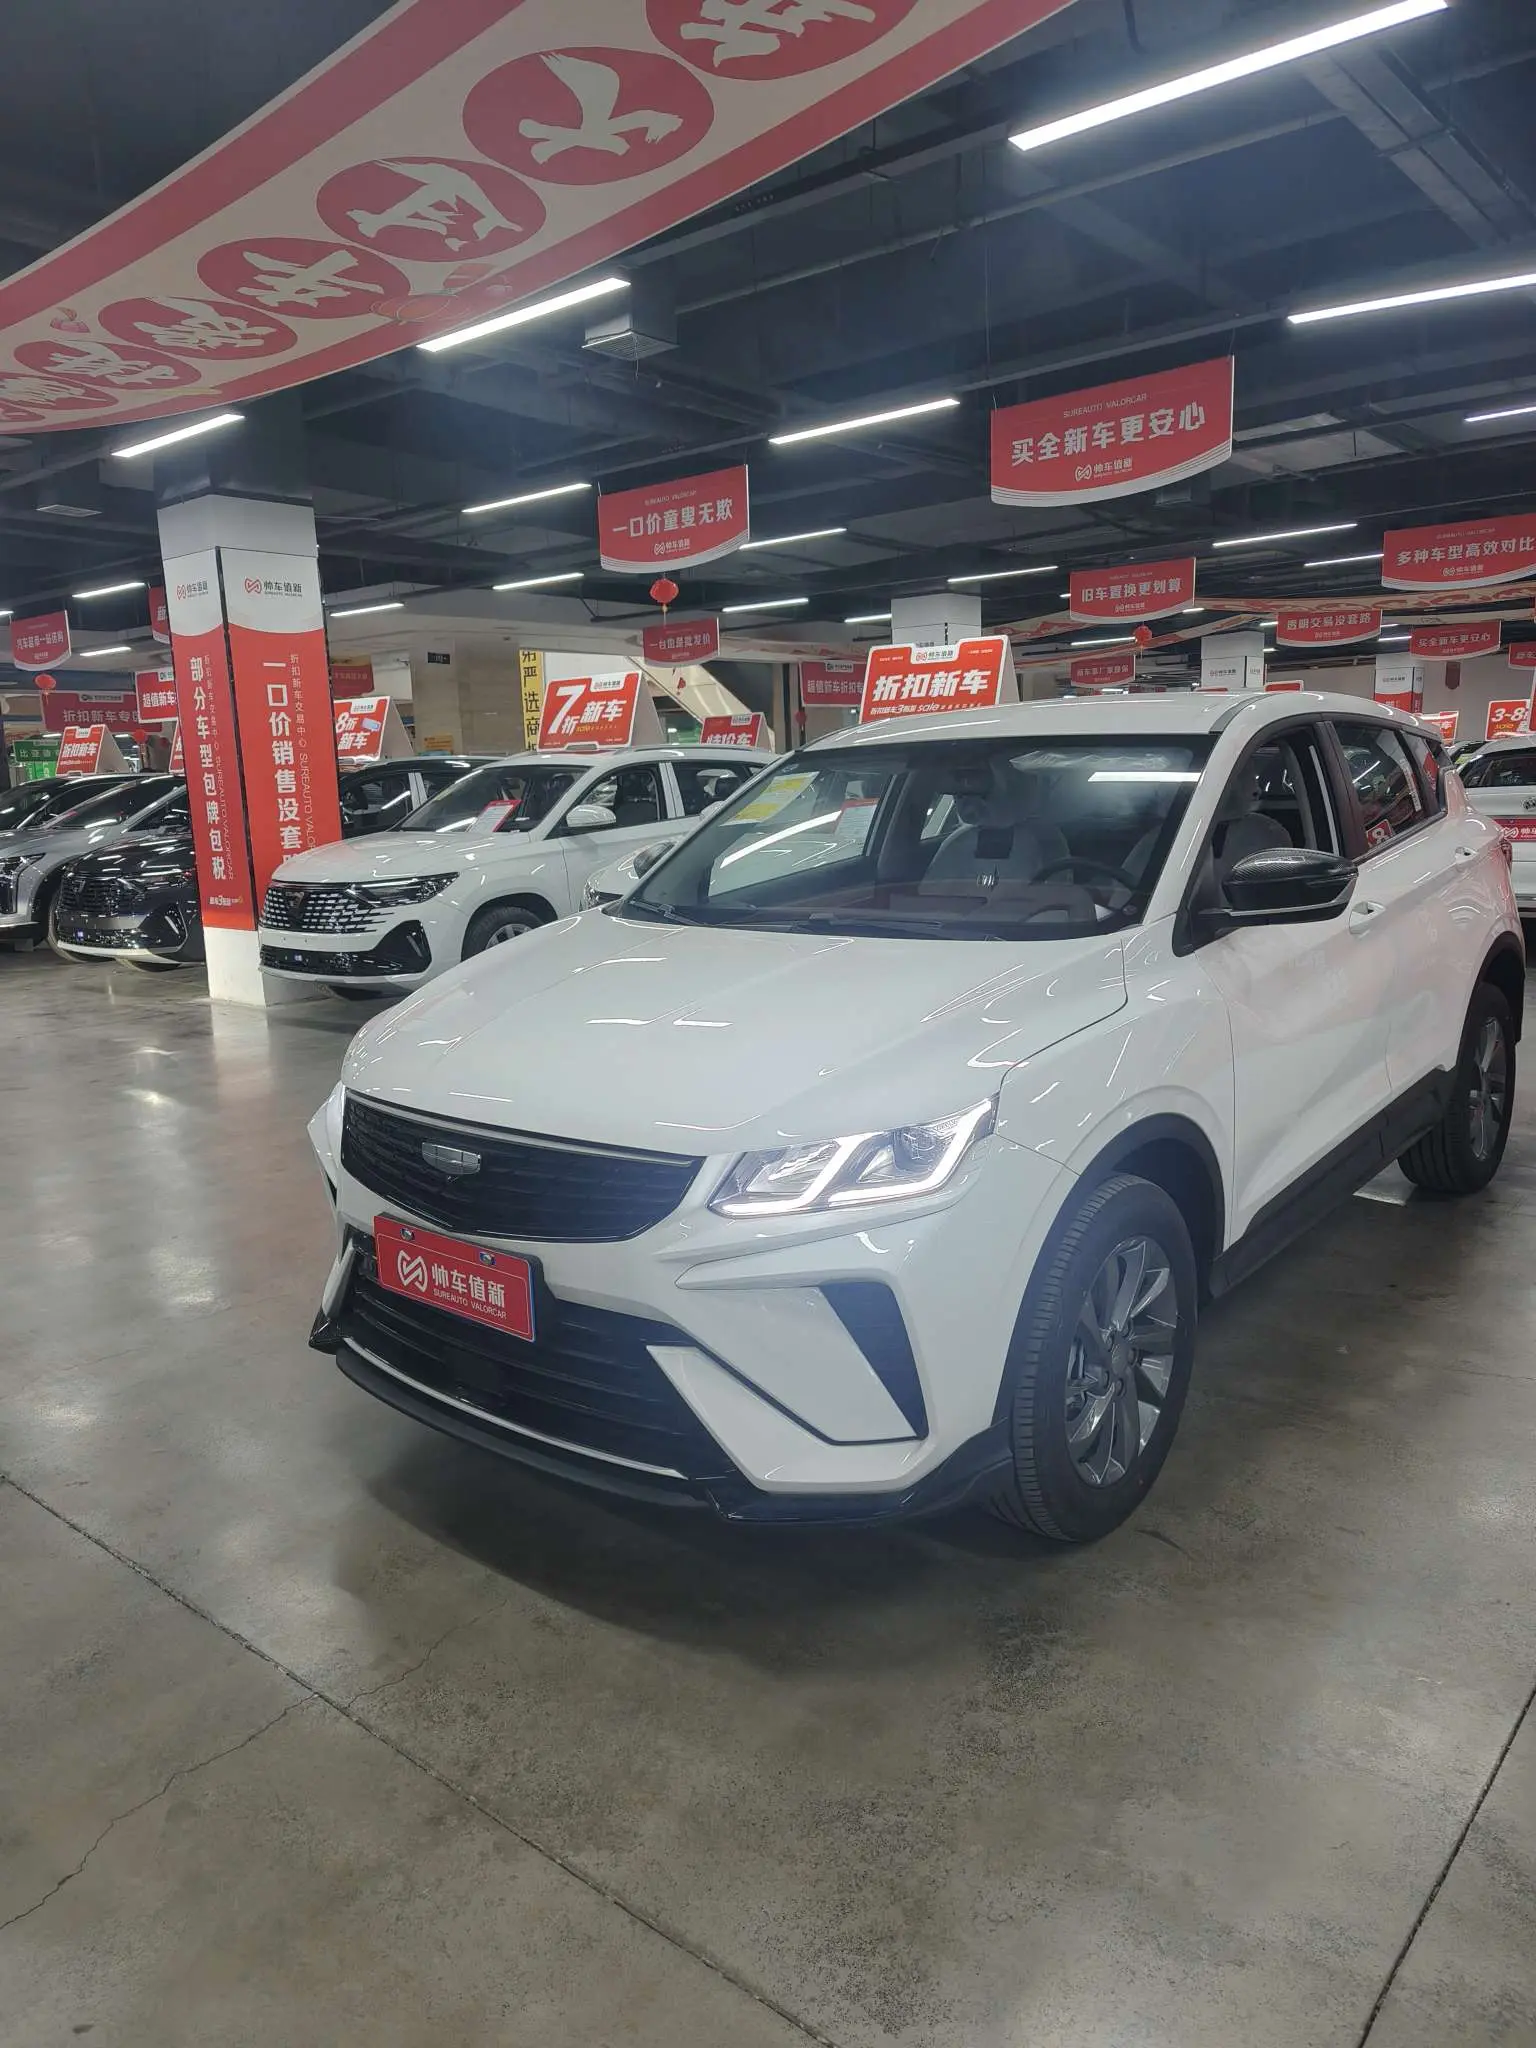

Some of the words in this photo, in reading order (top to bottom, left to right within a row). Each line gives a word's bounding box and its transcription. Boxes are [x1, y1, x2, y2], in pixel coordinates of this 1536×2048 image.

[1011, 401, 1206, 467] 买全新车更安心
[612, 497, 733, 538] 一口价童叟无欺
[1396, 536, 1536, 566] 多种车型高效对比
[1081, 578, 1181, 603] 旧车置换更划算
[1286, 613, 1372, 631] 透明交易没套路
[290, 653, 308, 748] 折扣新车交易中心
[872, 669, 992, 702] 折扣新车
[917, 702, 940, 712] sale
[62, 743, 99, 758] 折扣新车
[338, 732, 370, 749] 新车
[189, 657, 227, 881] 部分车型包牌包税
[298, 753, 313, 814] SUREAUTO
[432, 1263, 506, 1308] 帅车值新
[433, 1288, 469, 1306] SUREAUTO
[471, 1301, 507, 1319] VALORCAR
